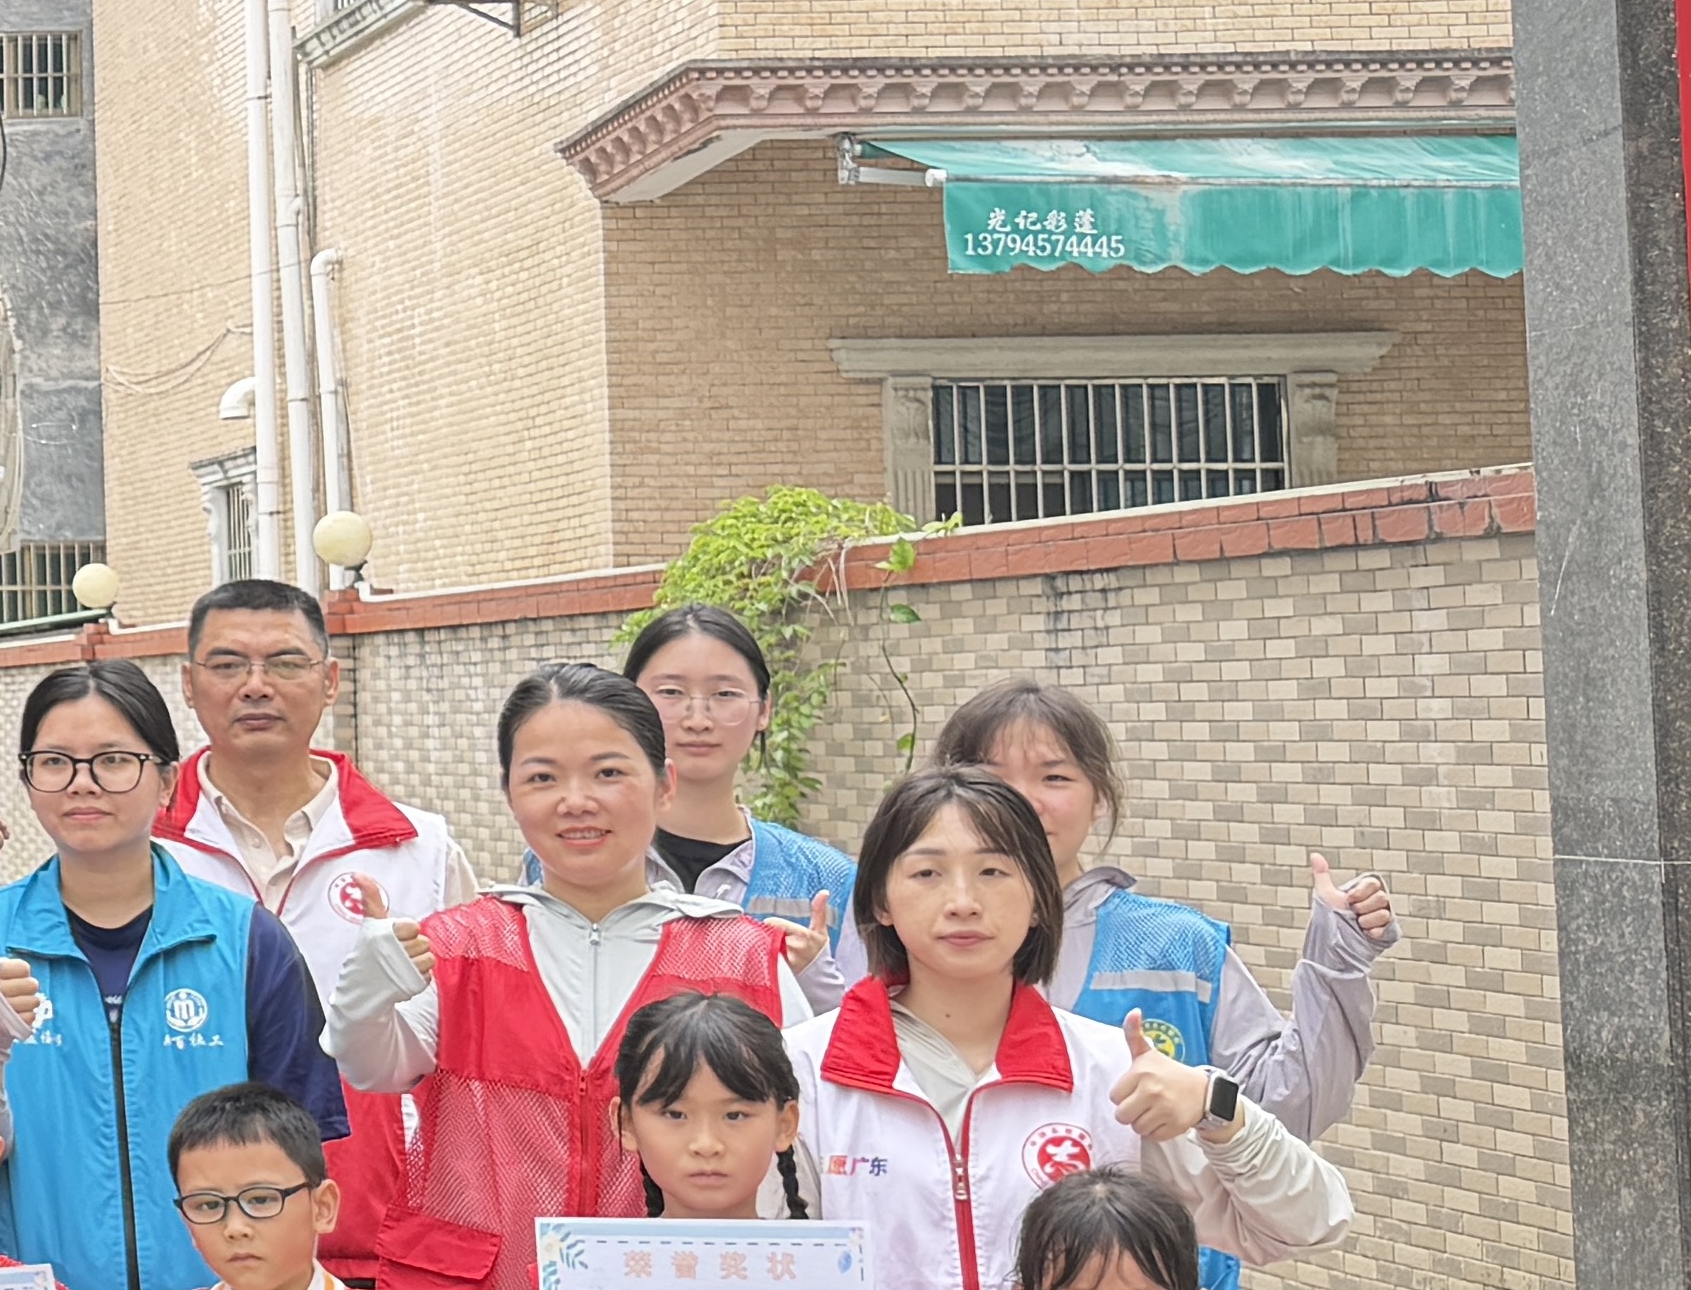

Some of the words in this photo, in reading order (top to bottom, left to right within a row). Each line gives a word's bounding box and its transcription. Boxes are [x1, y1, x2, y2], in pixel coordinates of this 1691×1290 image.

[963, 233, 1126, 258] 13794574445
[819, 1154, 889, 1177] 愿广东
[622, 1249, 797, 1283] 荣誉奖状
